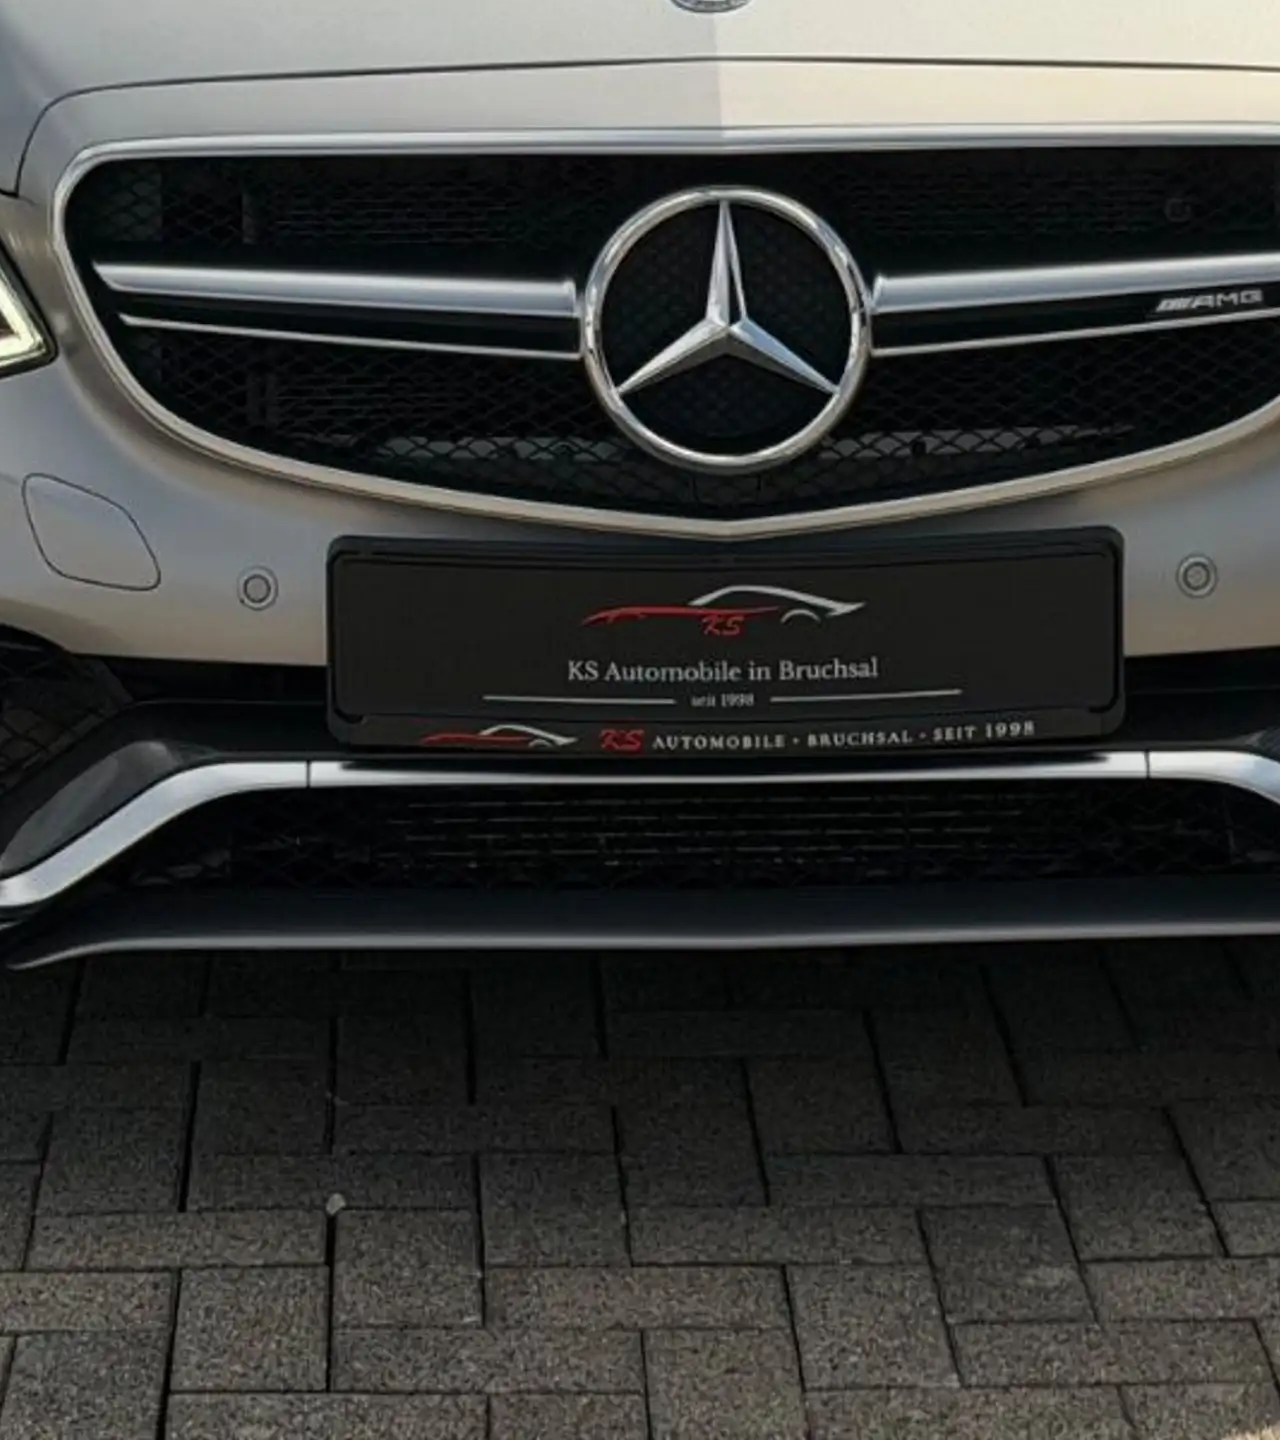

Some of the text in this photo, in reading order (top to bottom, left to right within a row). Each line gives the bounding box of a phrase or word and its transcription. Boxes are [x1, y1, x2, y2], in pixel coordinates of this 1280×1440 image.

[701, 615, 745, 637] KS
[568, 657, 879, 682] KS Automobile in Bruchsal
[690, 692, 717, 708] seit
[651, 733, 786, 752] AUTOMOBILE
[806, 729, 913, 749] BRUCHSAL
[932, 724, 977, 742] SEIT
[984, 719, 1036, 740] 1998
